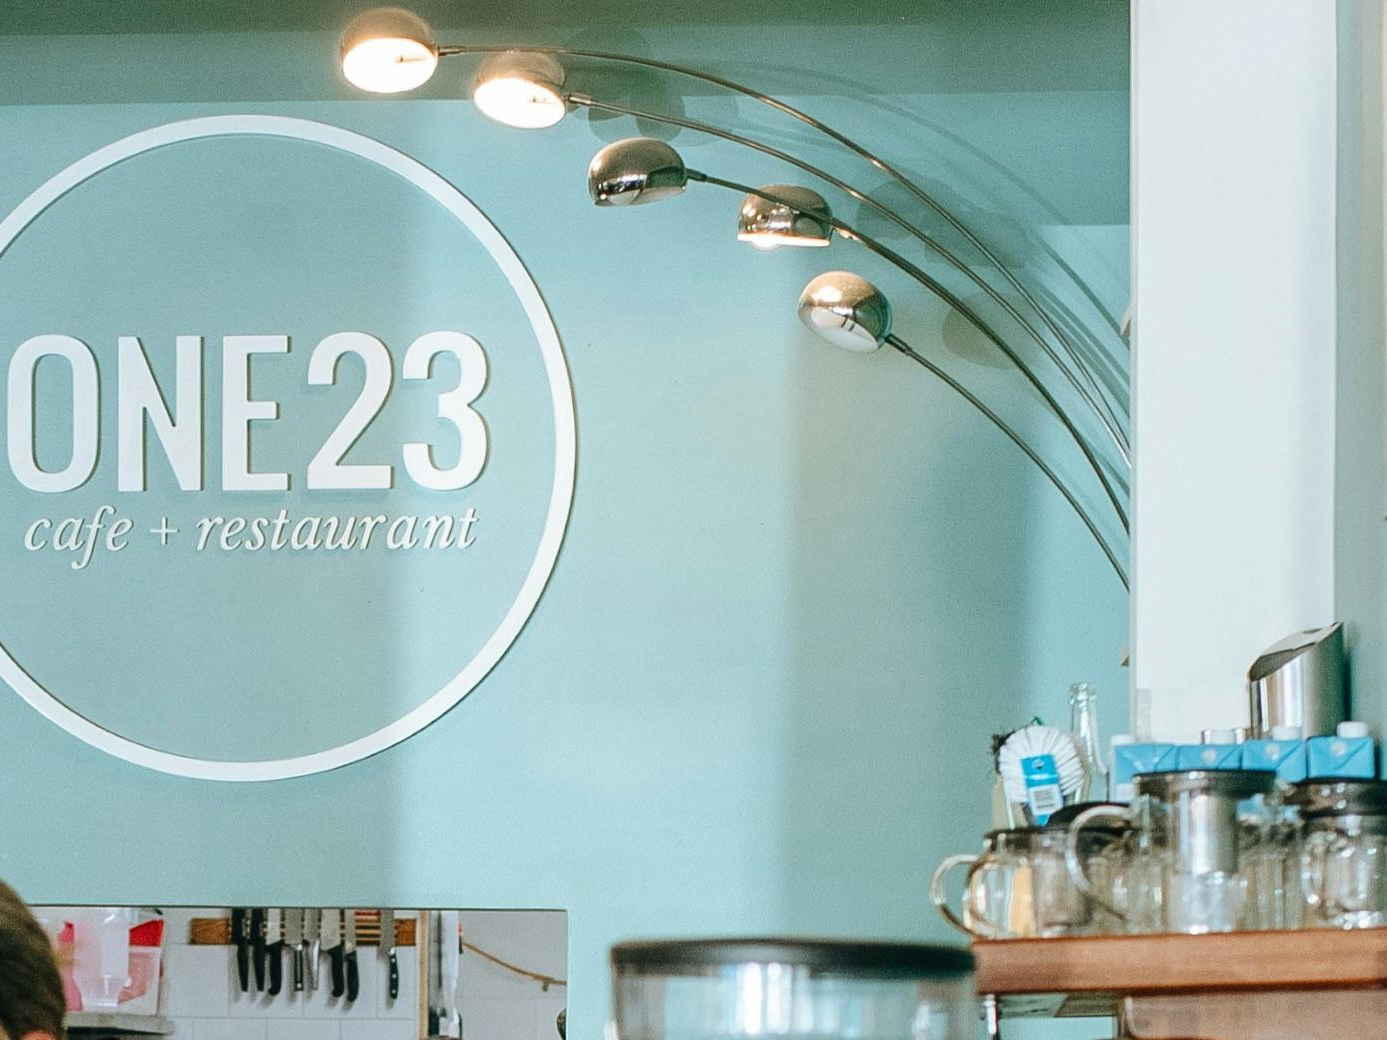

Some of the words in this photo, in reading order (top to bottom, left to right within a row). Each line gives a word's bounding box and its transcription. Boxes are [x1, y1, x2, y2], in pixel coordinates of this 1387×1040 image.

[7, 331, 488, 492] ONE23
[24, 505, 133, 569] cafe
[197, 507, 478, 551] restaurant
